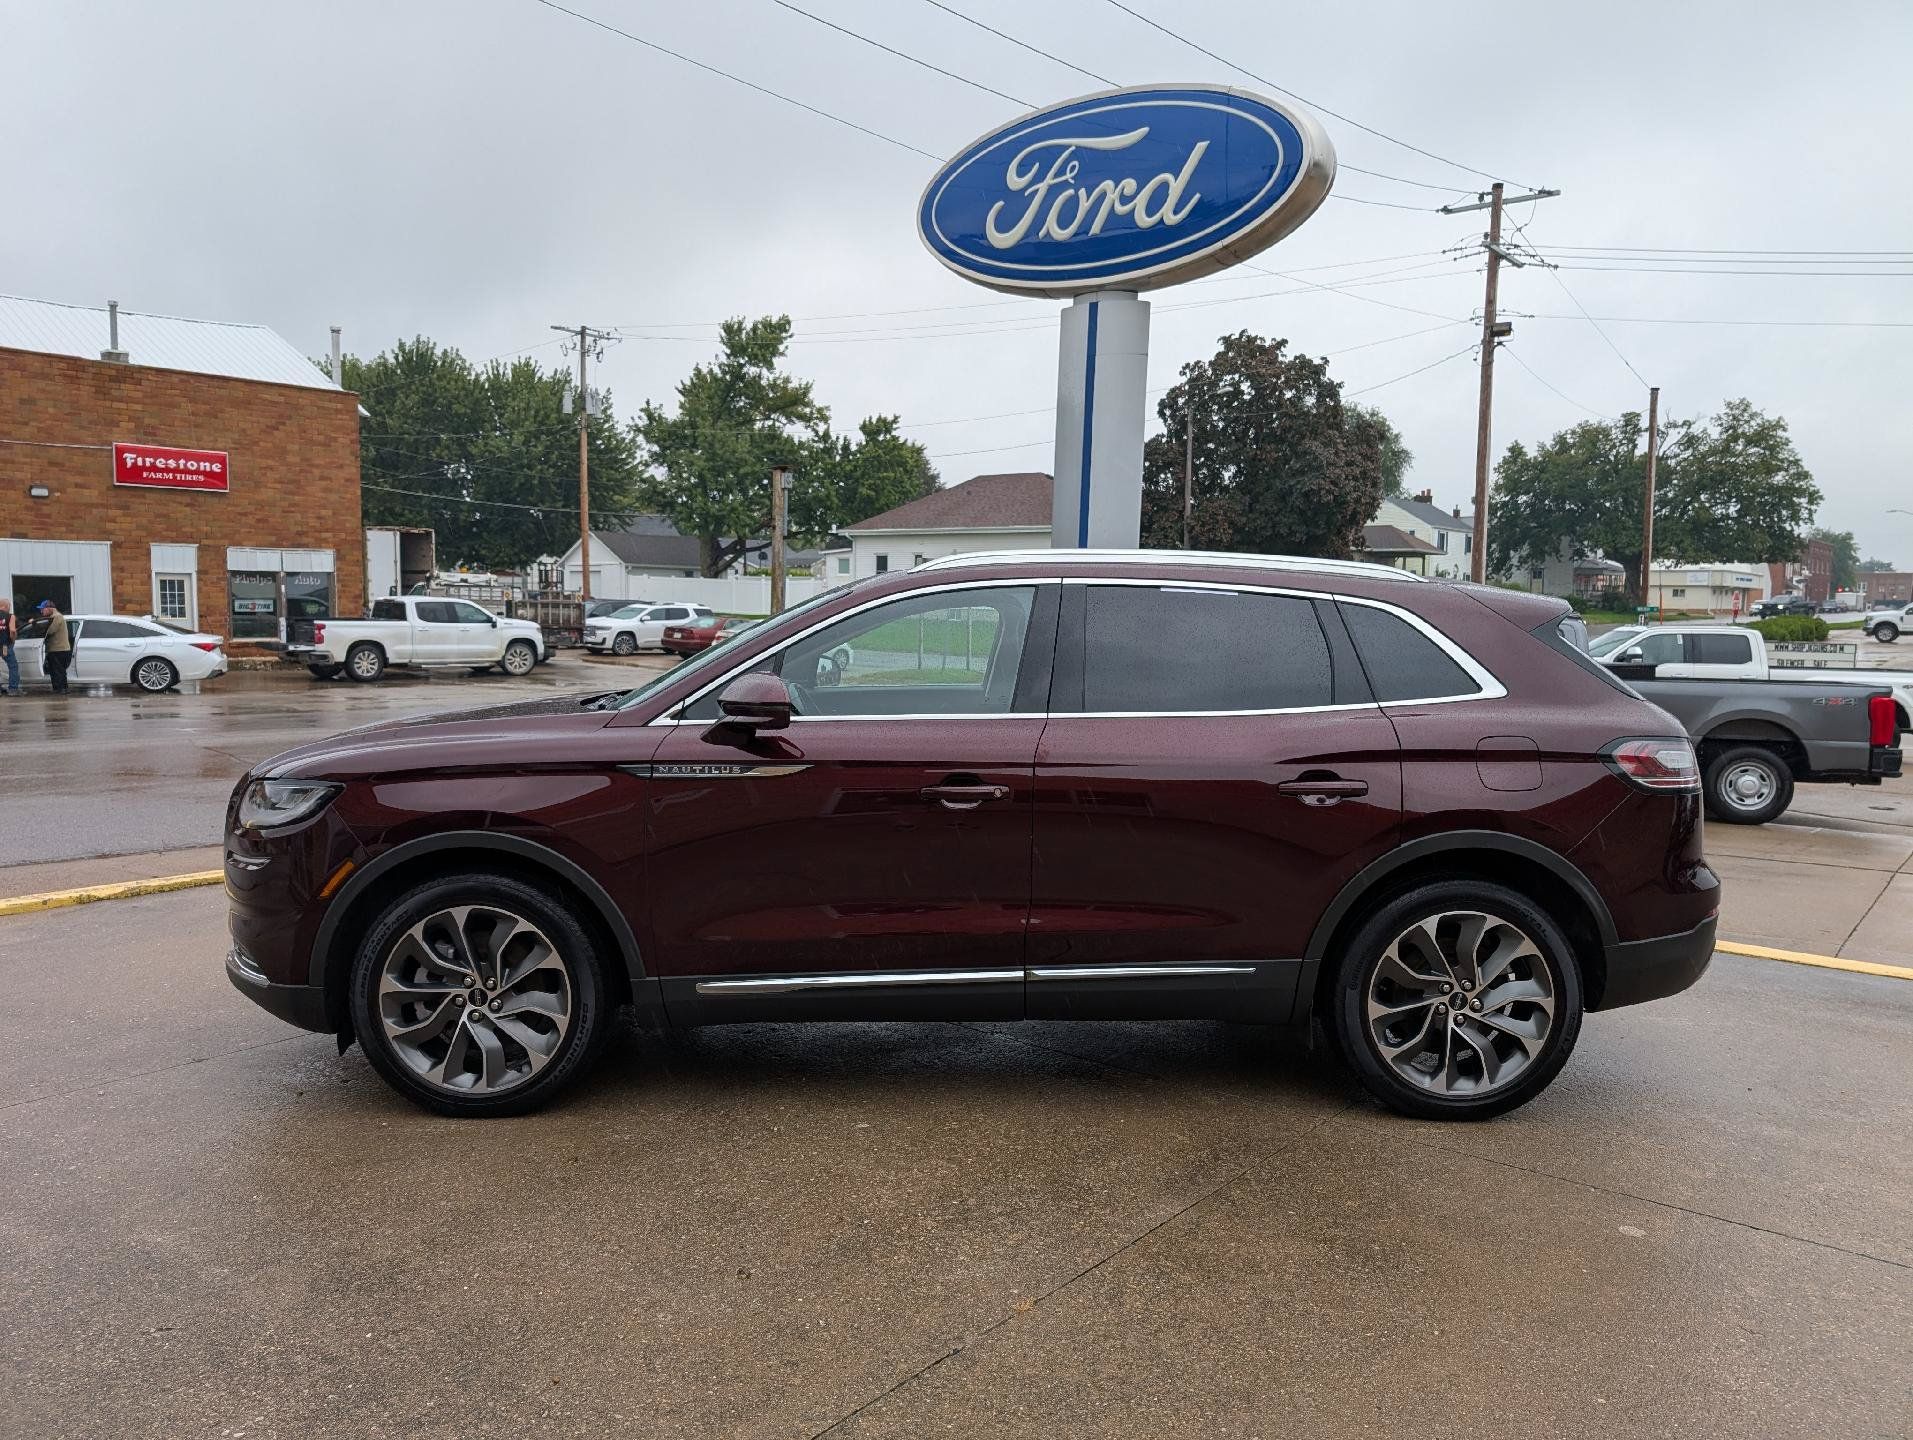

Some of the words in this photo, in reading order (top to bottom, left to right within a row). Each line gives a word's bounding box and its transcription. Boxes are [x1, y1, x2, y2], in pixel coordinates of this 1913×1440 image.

[985, 126, 1210, 249] Ford
[122, 452, 222, 473] Firestone
[142, 471, 173, 480] FARM
[175, 472, 205, 482] TIRES
[658, 766, 742, 775] NAUTILUS
